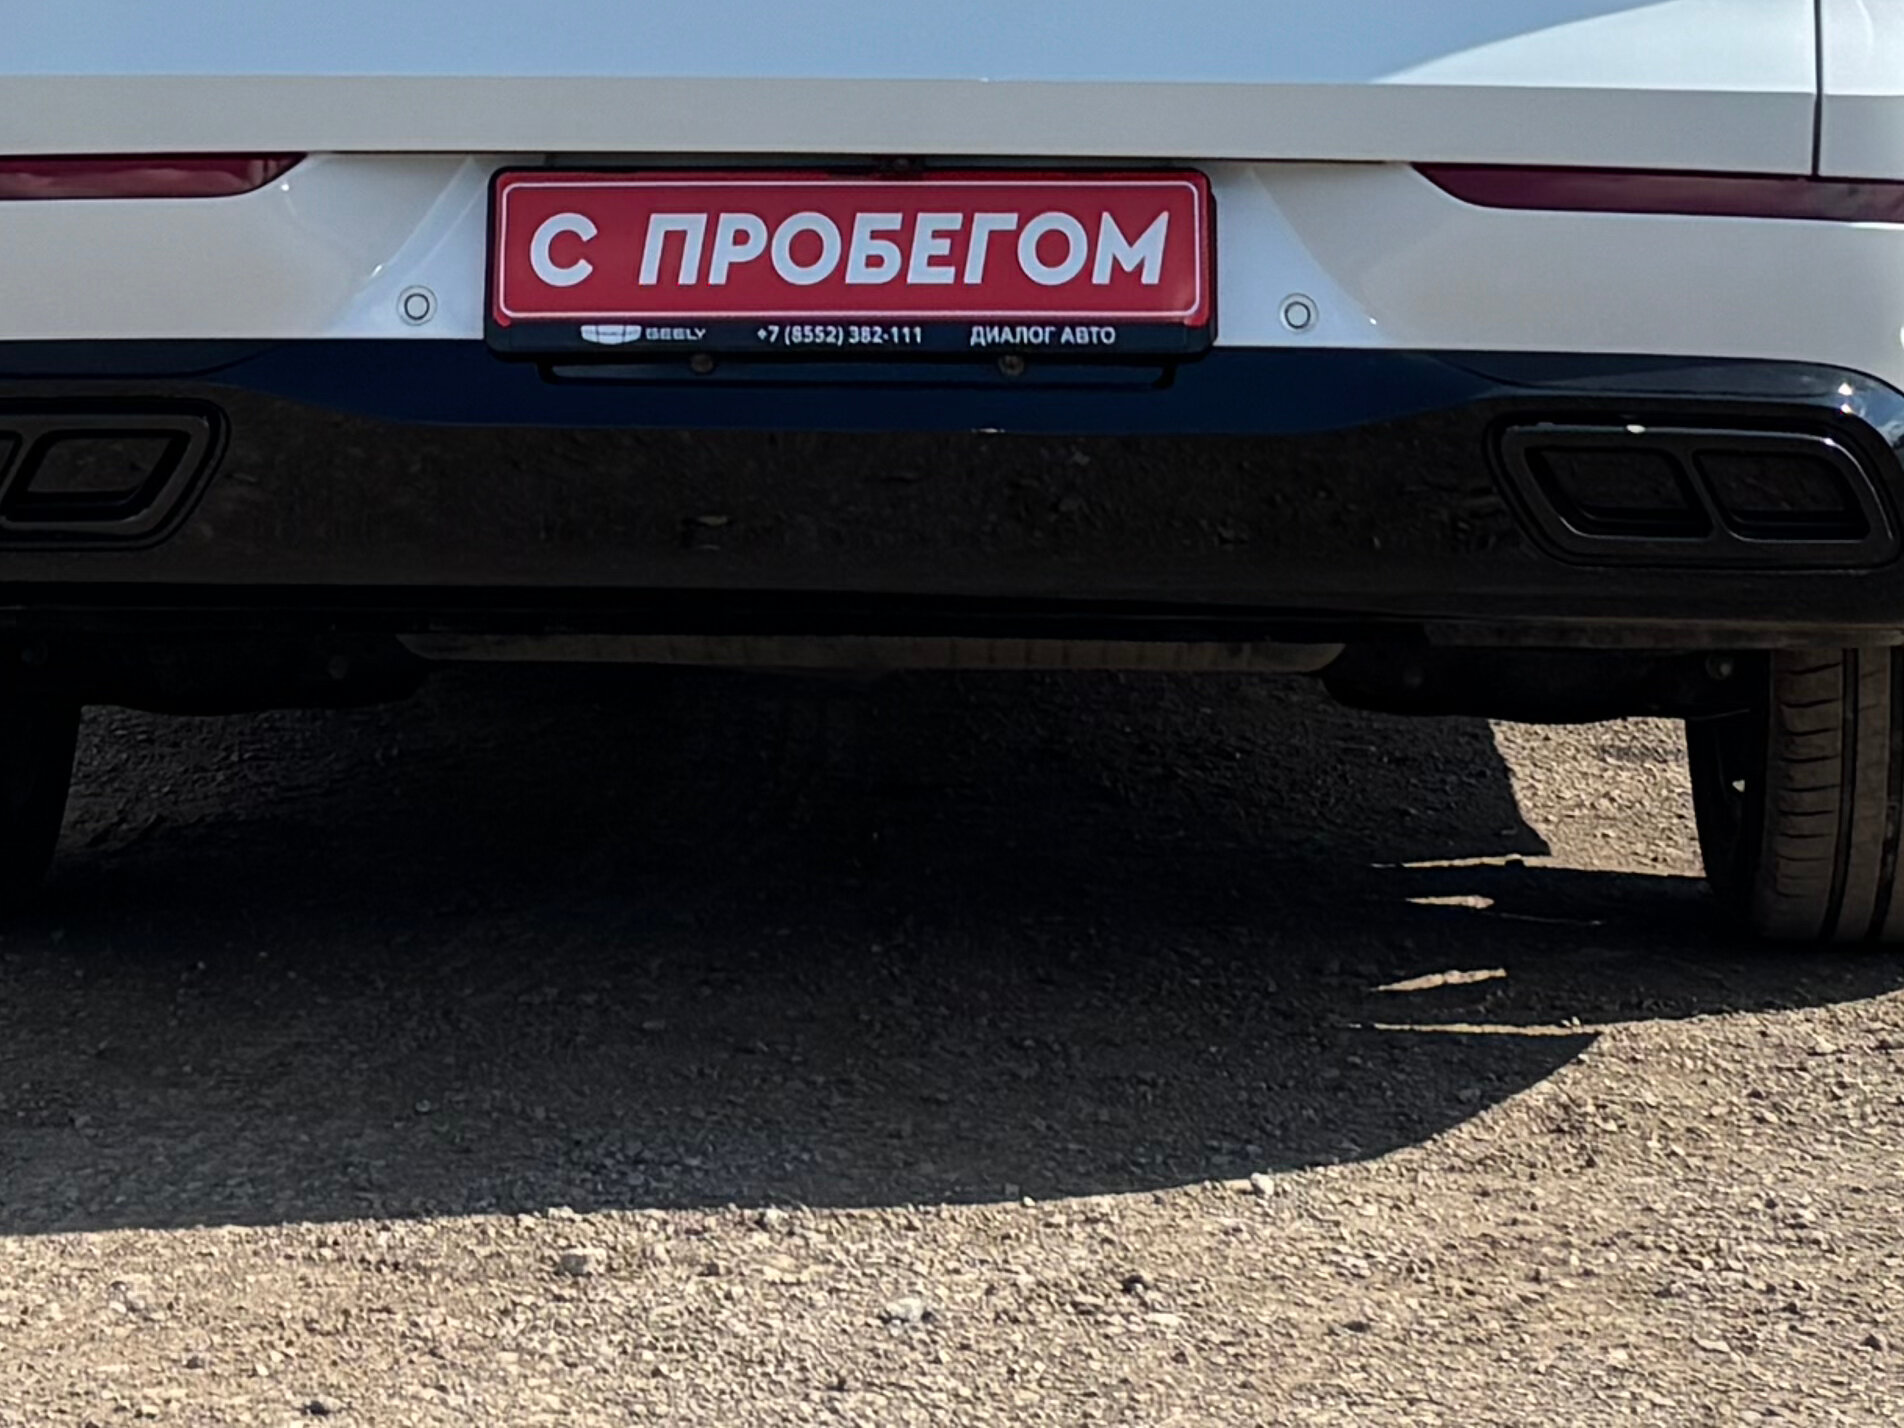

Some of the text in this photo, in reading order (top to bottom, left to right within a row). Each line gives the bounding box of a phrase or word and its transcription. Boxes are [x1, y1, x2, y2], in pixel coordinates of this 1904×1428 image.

[529, 210, 1170, 287] С ПРОБЕГОМ
[783, 325, 844, 346] (8552)
[847, 325, 923, 344] 382-111
[969, 325, 1117, 347] ДИАЛОГ АВТО
